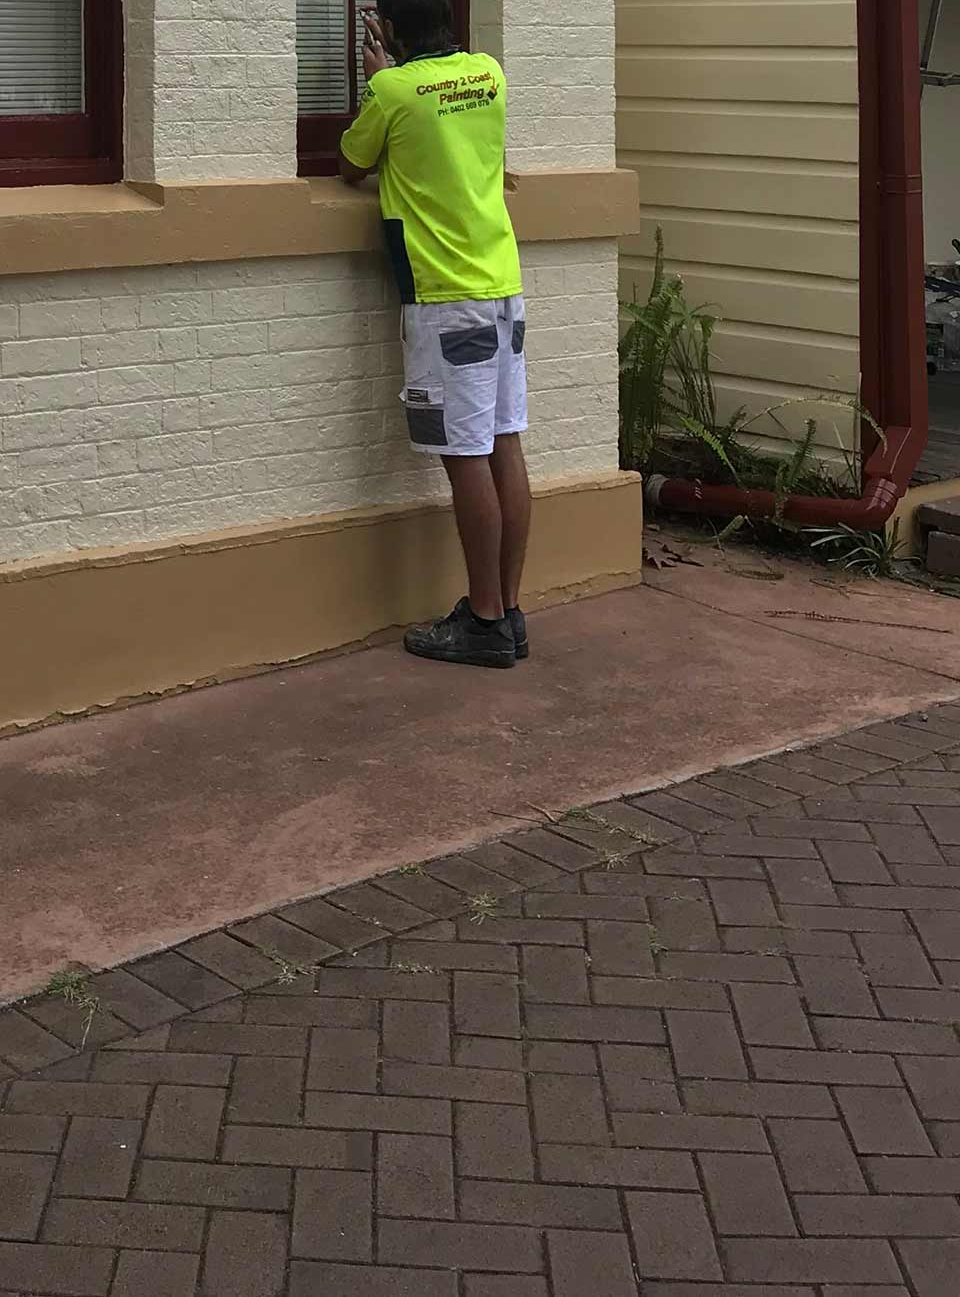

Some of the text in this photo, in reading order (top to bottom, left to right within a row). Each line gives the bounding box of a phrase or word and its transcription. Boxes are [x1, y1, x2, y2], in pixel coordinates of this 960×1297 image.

[416, 71, 492, 96] Country 2 Coast
[439, 88, 484, 105] Painting
